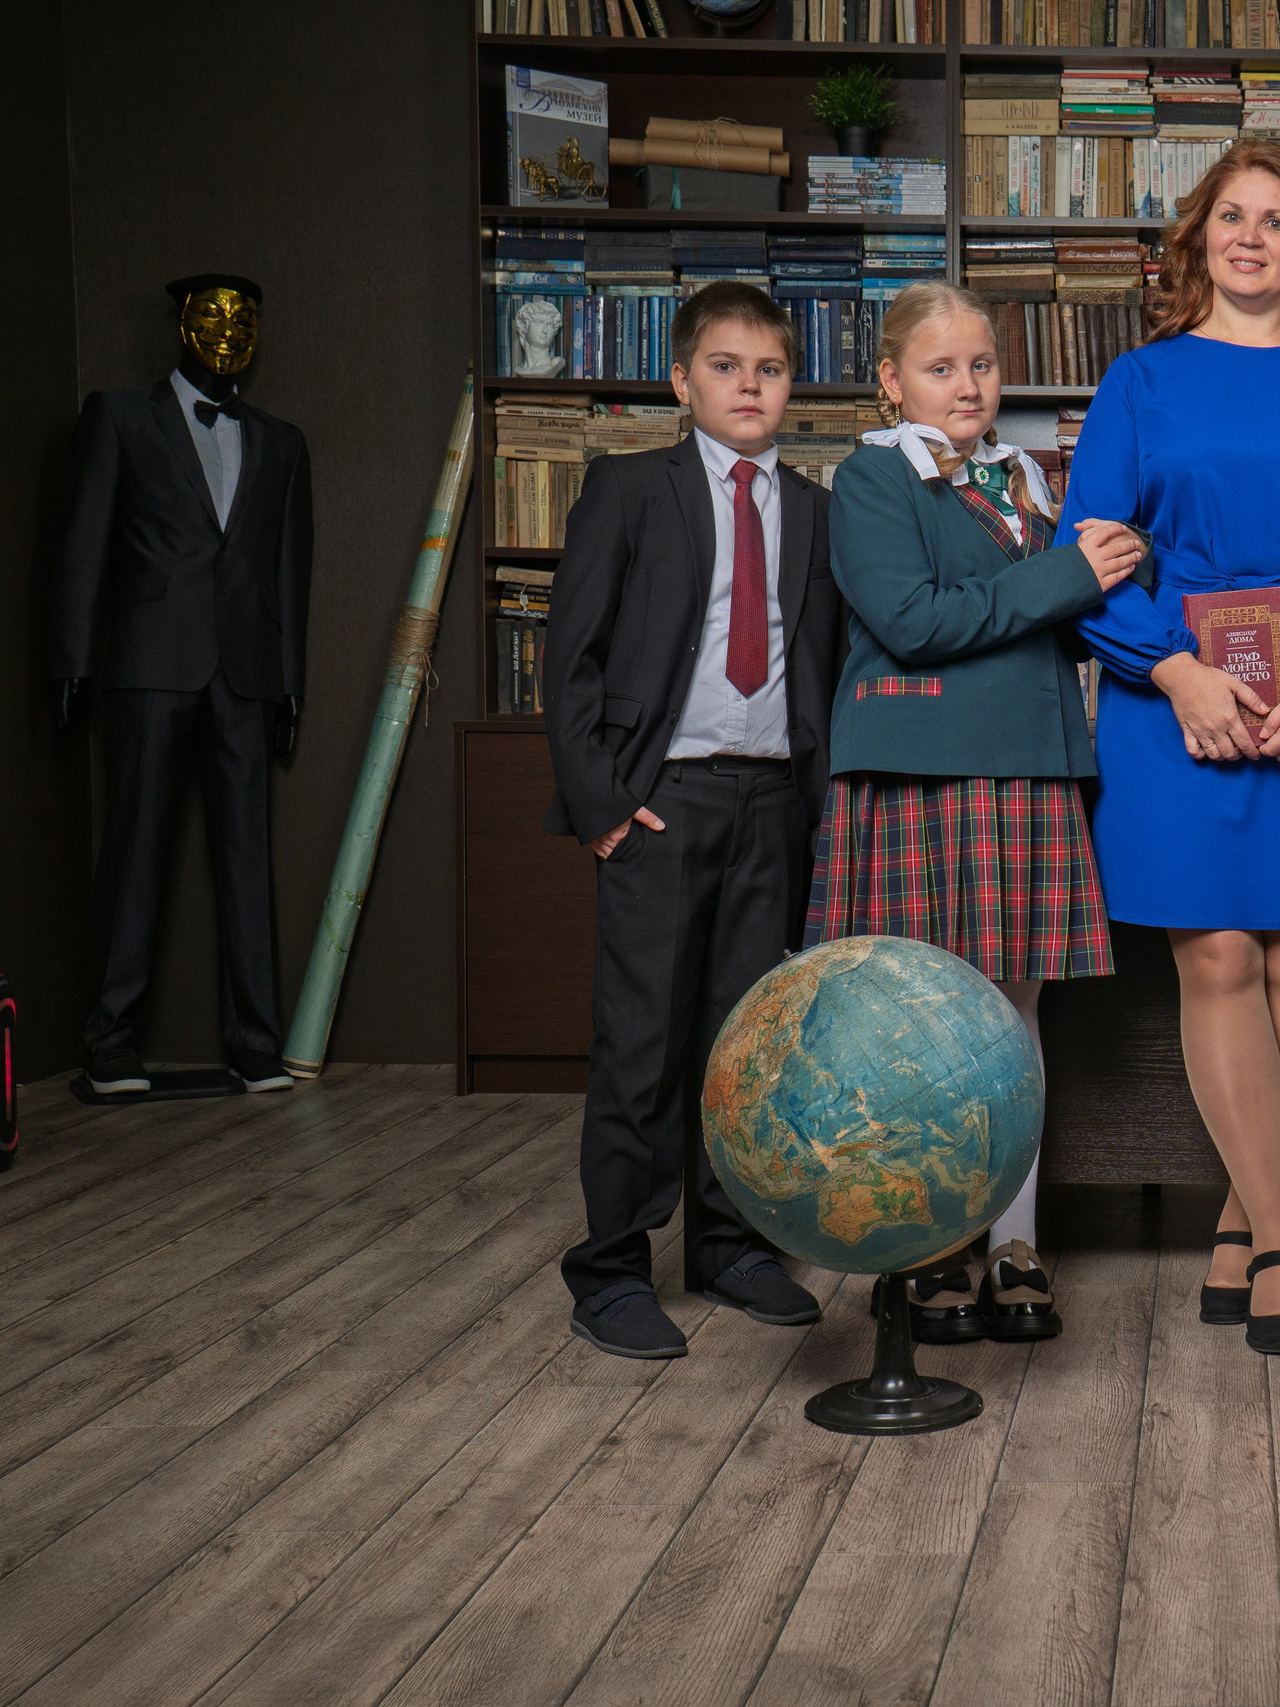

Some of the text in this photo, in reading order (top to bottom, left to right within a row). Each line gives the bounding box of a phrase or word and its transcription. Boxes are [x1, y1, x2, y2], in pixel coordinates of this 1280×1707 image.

[1250, 0, 1261, 24] МАН
[519, 89, 602, 113] БРИТАНСКИЙ
[566, 109, 602, 123] МУЗЕЙ
[1225, 629, 1257, 638] АЛЕКСАНДР
[1228, 635, 1255, 644] ДЮМА
[1226, 651, 1261, 664] ГРАФ
[1230, 670, 1271, 683] РИСТО
